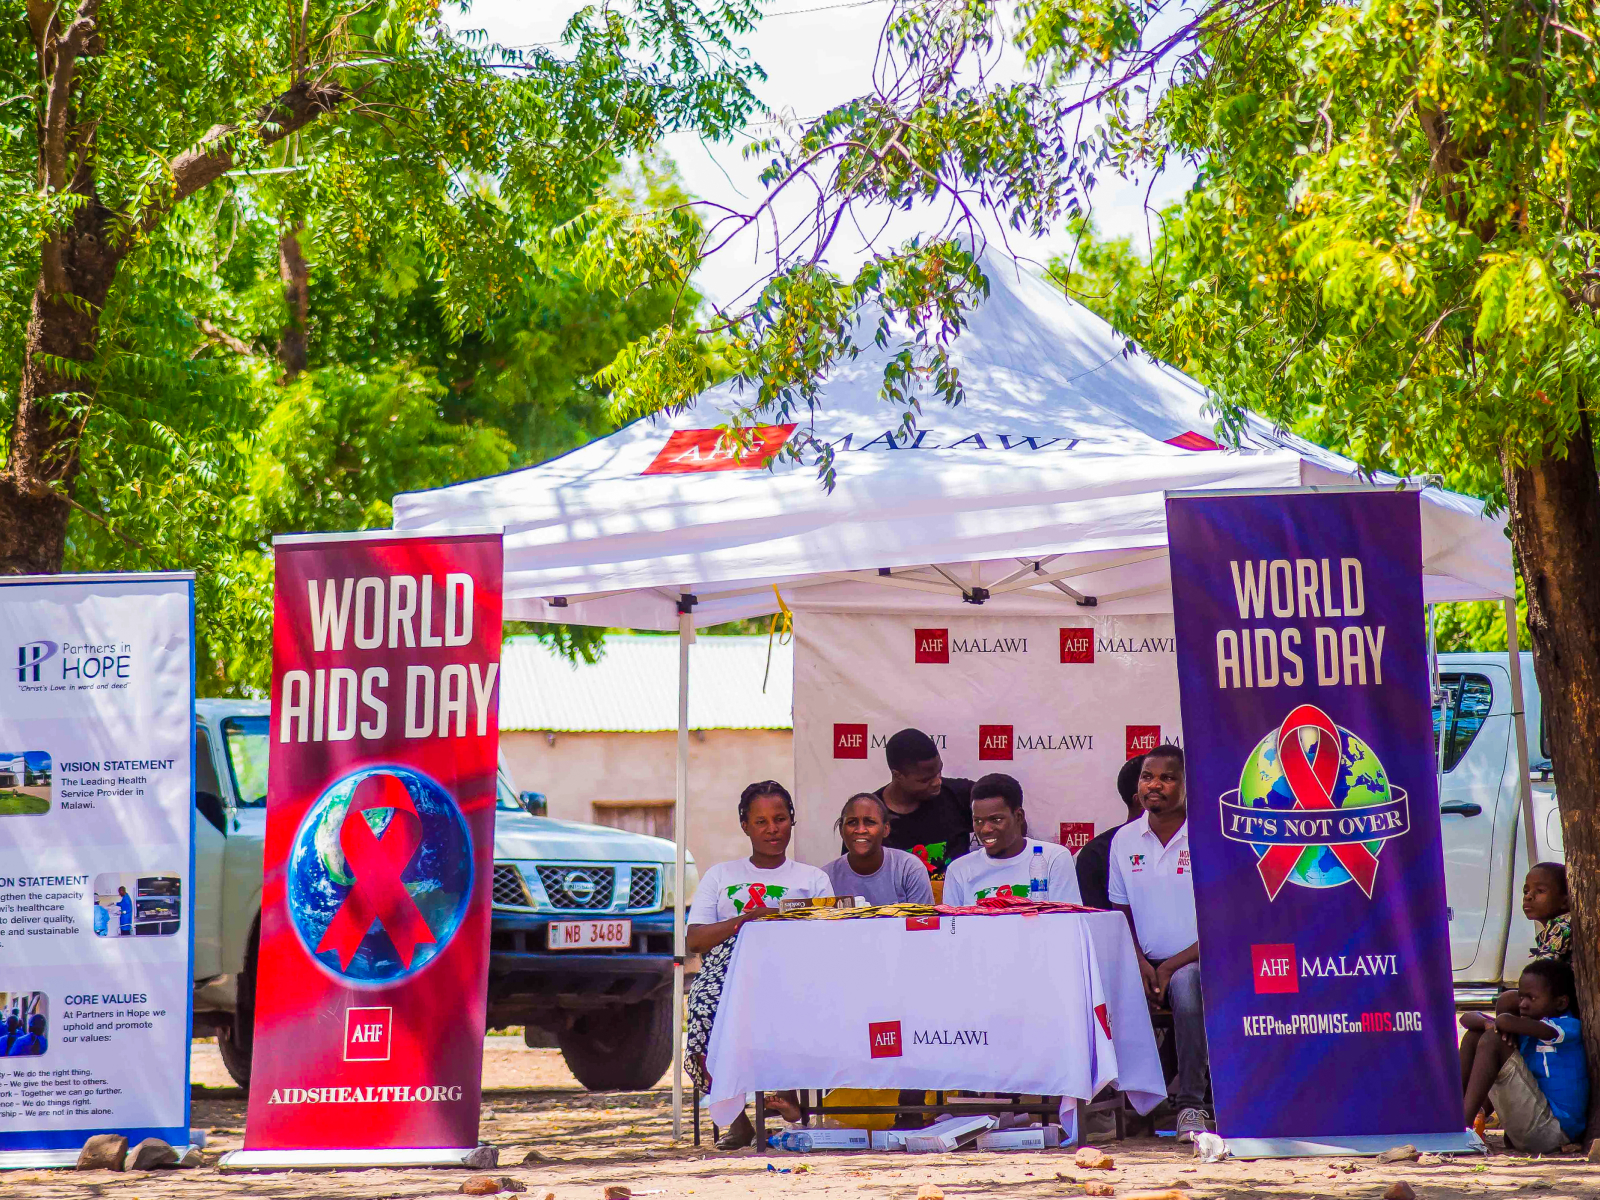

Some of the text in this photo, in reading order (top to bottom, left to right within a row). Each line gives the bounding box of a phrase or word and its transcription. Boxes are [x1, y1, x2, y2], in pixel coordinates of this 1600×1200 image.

[1230, 558, 1365, 619] WORLD
[308, 573, 474, 652] WORLD
[63, 642, 131, 655] Partners in
[920, 637, 1028, 653] AHF MALAWI
[1064, 637, 1176, 654] AHF MALAWI
[1216, 625, 1386, 689] AIDS DAY
[63, 655, 131, 680] HOPE
[280, 662, 499, 743] AIDS DAY
[838, 734, 863, 747] AHF
[984, 735, 1093, 750] AHF MALAWI
[1131, 735, 1156, 749] AHF
[60, 760, 175, 772] VISION STATEMENT
[61, 776, 147, 787] The Leading Health
[61, 787, 144, 798] Service Provider in
[61, 801, 95, 809] Malawi.
[1229, 810, 1403, 837] IT'S NOT OVER
[1066, 833, 1089, 847] AHF
[18, 875, 89, 887] STATEMENT
[0, 891, 84, 902] gthen the capacity
[17, 903, 65, 912] healthcare
[10, 915, 41, 924] deliver
[43, 914, 75, 925] quality,
[8, 927, 25, 936] and
[27, 926, 79, 936] sustainable
[565, 924, 581, 943] NB
[590, 923, 623, 943] 3488
[1260, 954, 1398, 978] AHF MALAWI
[64, 993, 147, 1005] CORE VALUES
[63, 1011, 73, 1019] At
[76, 1010, 114, 1018] Partners
[126, 1009, 150, 1018] Hope
[63, 1020, 153, 1032] uphold and promote
[1243, 1011, 1422, 1037] KEEPthePROMISEonAIDS.ORG
[63, 1034, 111, 1043] our values:
[351, 1024, 383, 1044] AHF
[875, 1029, 988, 1046] AHF MALAWI
[52, 1069, 70, 1077] right
[72, 1069, 92, 1077] thing.
[23, 1080, 39, 1089] give
[21, 1089, 54, 1098] Together
[84, 1089, 94, 1097] go
[268, 1085, 462, 1105] AIDSHEALTH.ORG
[36, 1099, 45, 1107] do
[47, 1099, 70, 1107] things
[72, 1098, 91, 1106] right.
[25, 1109, 36, 1117] We
